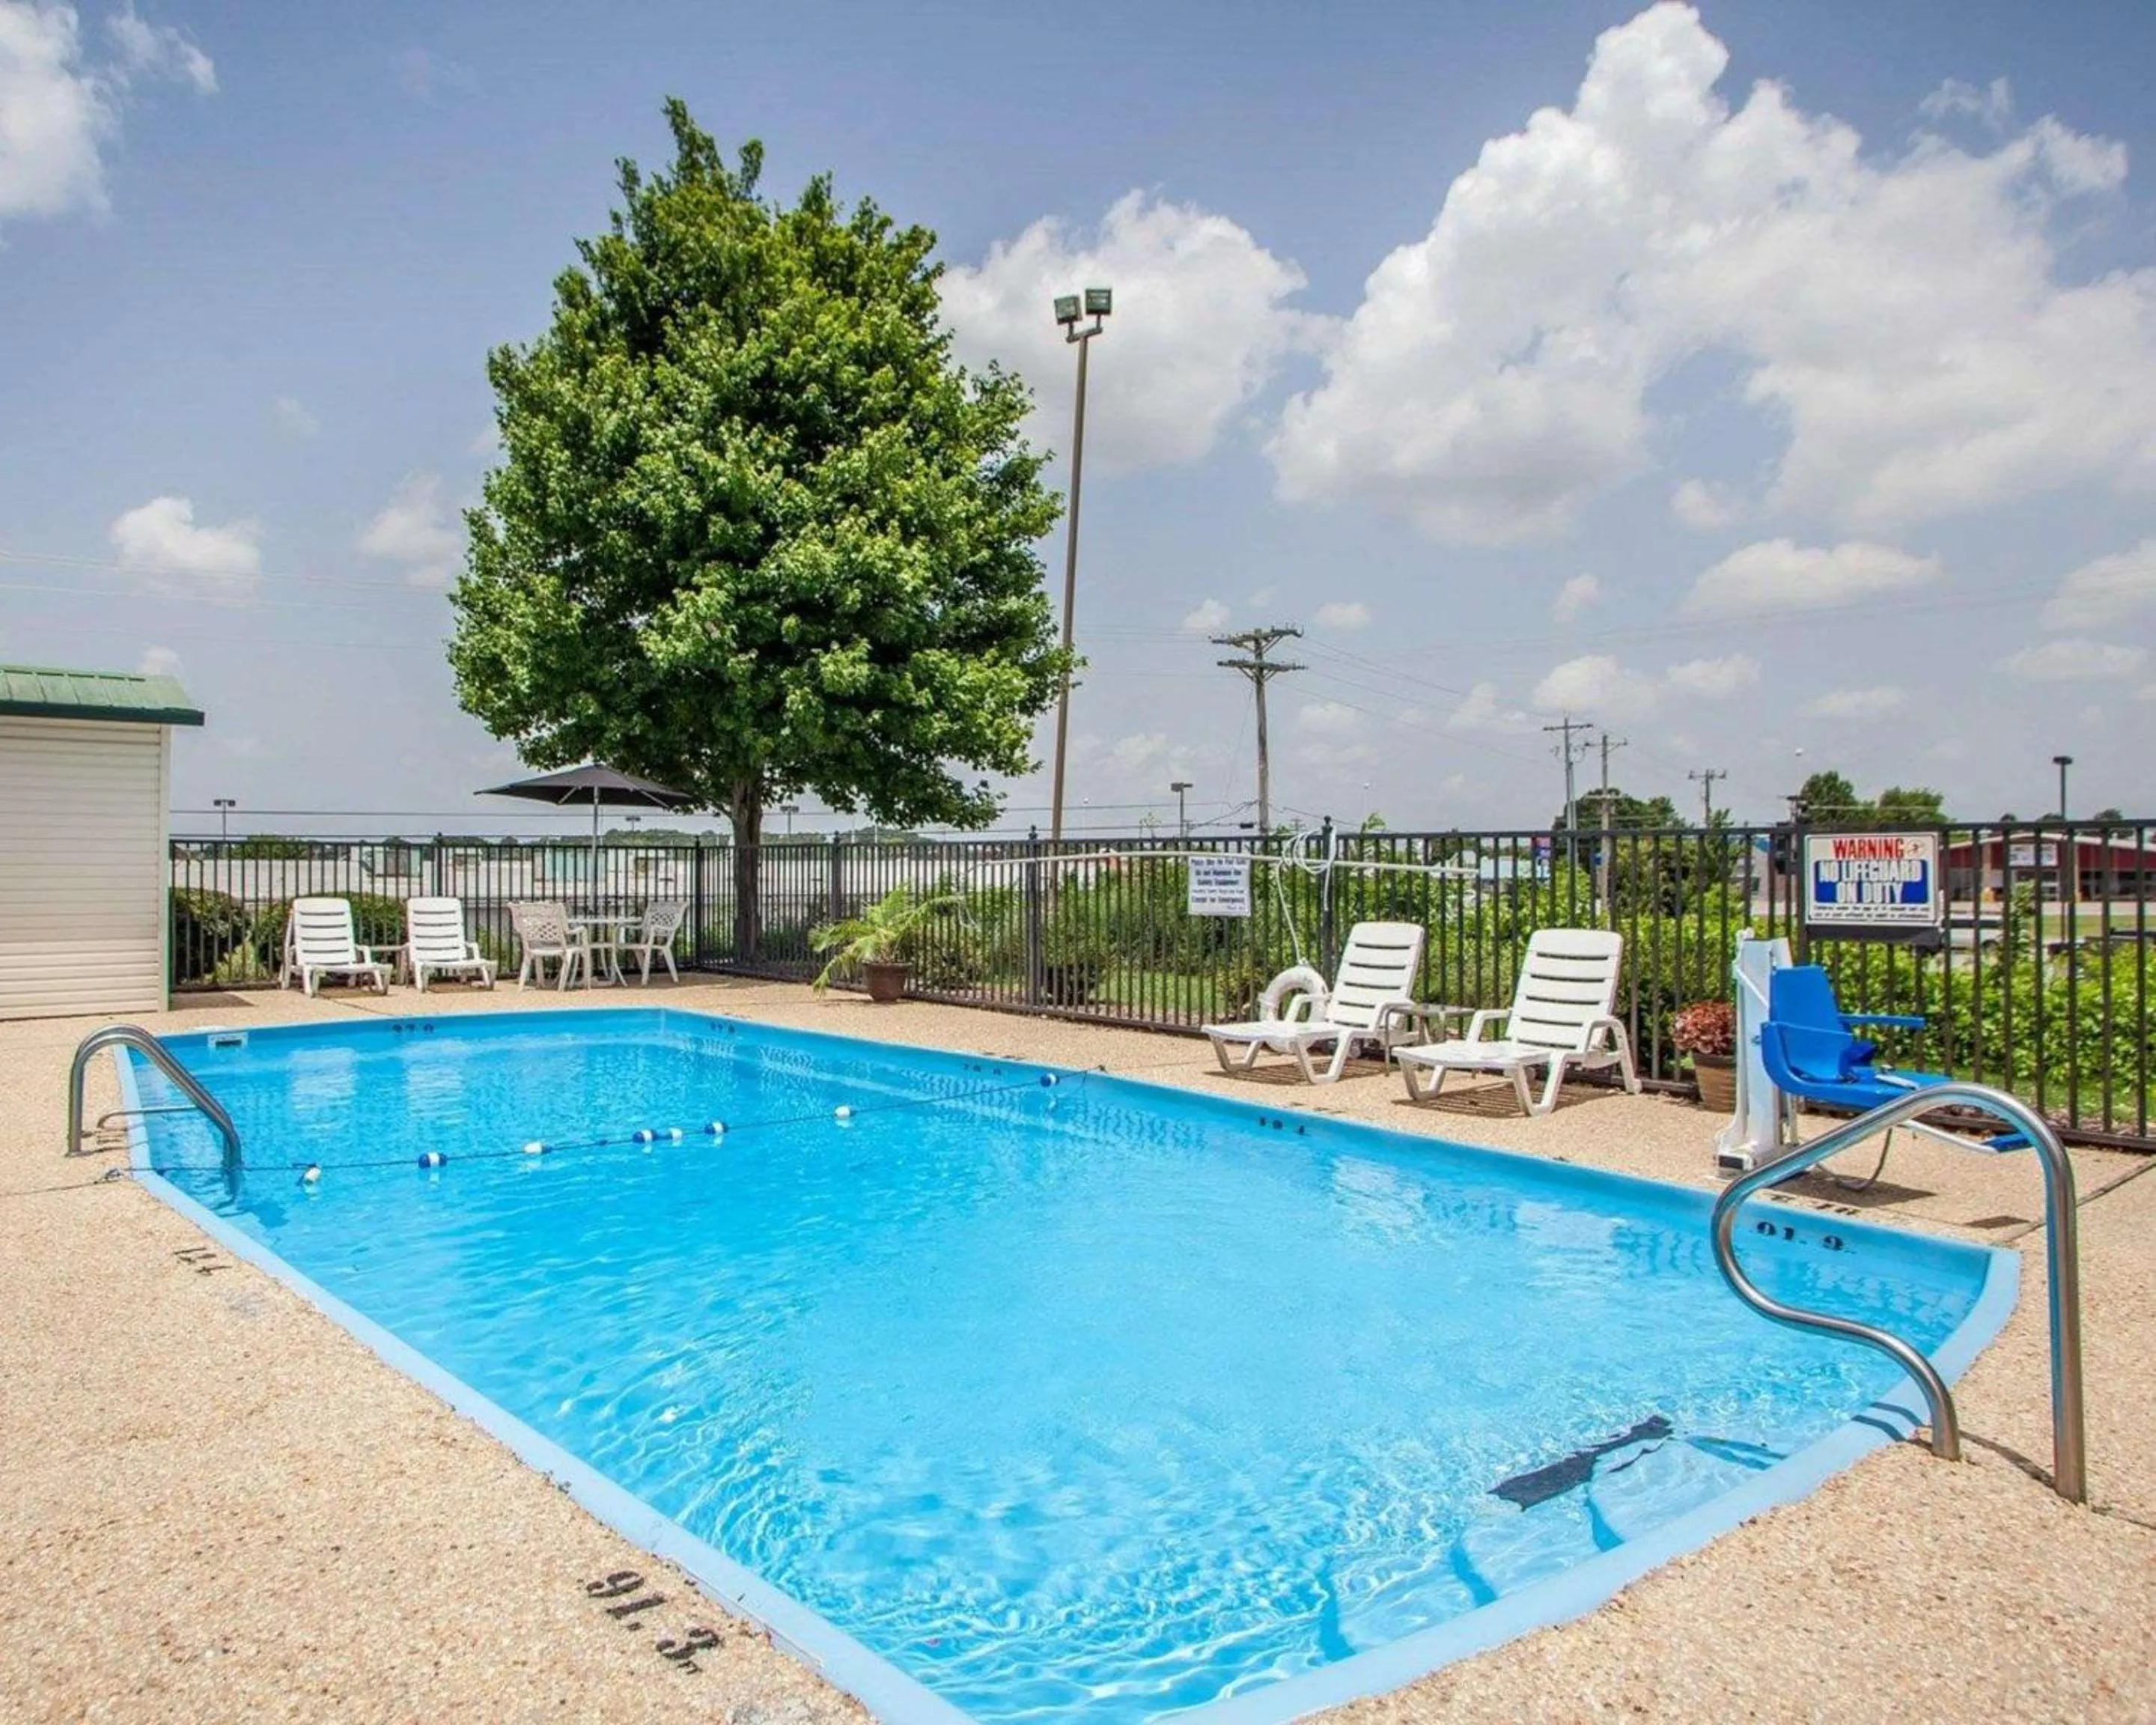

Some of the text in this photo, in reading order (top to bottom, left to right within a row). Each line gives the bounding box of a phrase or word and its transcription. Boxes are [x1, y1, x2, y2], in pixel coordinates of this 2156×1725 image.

[1833, 838, 1904, 859] WARNING
[1818, 861, 1922, 882] NO LIFEGUARD
[1836, 882, 1904, 903] ON DUTY
